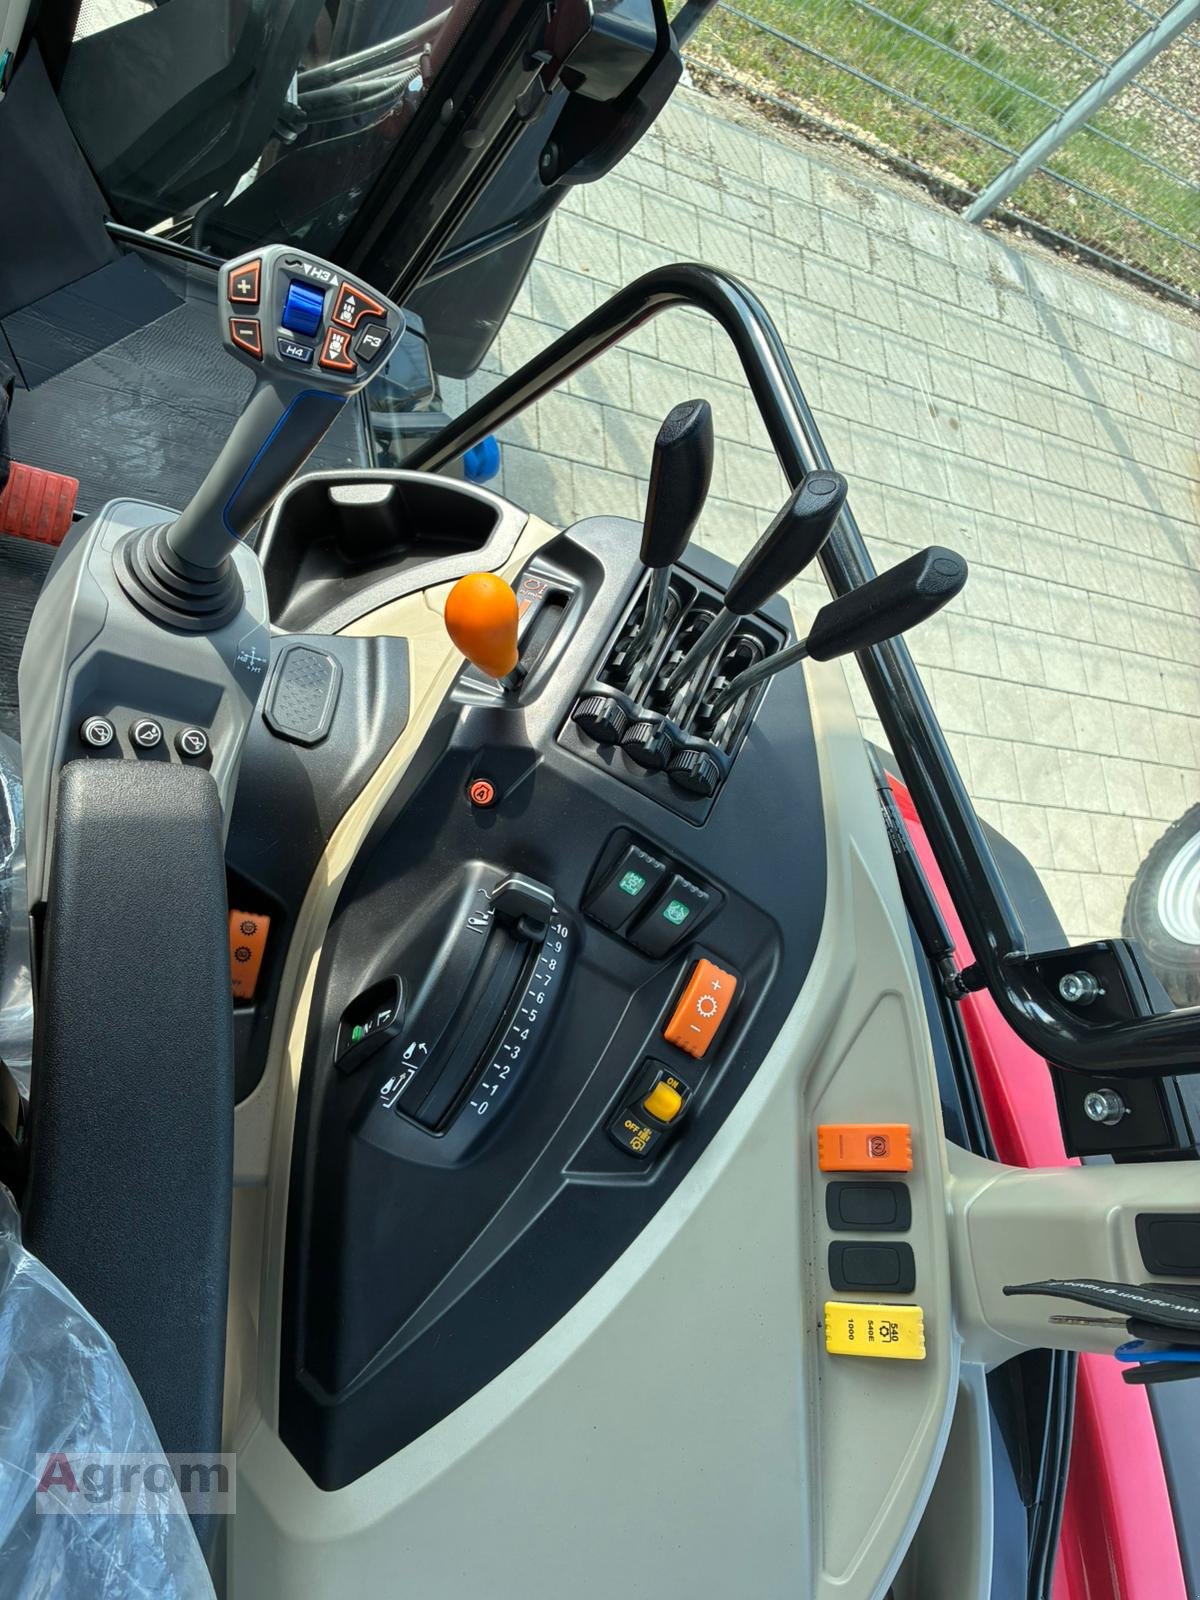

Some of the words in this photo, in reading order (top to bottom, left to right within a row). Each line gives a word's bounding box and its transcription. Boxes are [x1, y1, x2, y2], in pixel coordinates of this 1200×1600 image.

[310, 266, 331, 281] H3
[362, 334, 382, 347] F3
[286, 345, 304, 357] H4
[556, 924, 569, 938] 10
[554, 941, 562, 953] 9
[548, 959, 557, 971] 8
[543, 975, 552, 986] 7
[536, 992, 545, 1004] 6
[528, 1010, 538, 1022] 5
[520, 1028, 530, 1040] 4
[510, 1046, 521, 1059] 3
[500, 1065, 511, 1080] 2
[667, 1077, 679, 1089] ON
[490, 1084, 499, 1096] 1
[477, 1101, 489, 1115] 0
[624, 1120, 640, 1133] OFF
[847, 1318, 855, 1341] 1000
[867, 1320, 875, 1342] 540E
[890, 1323, 899, 1342] 540
